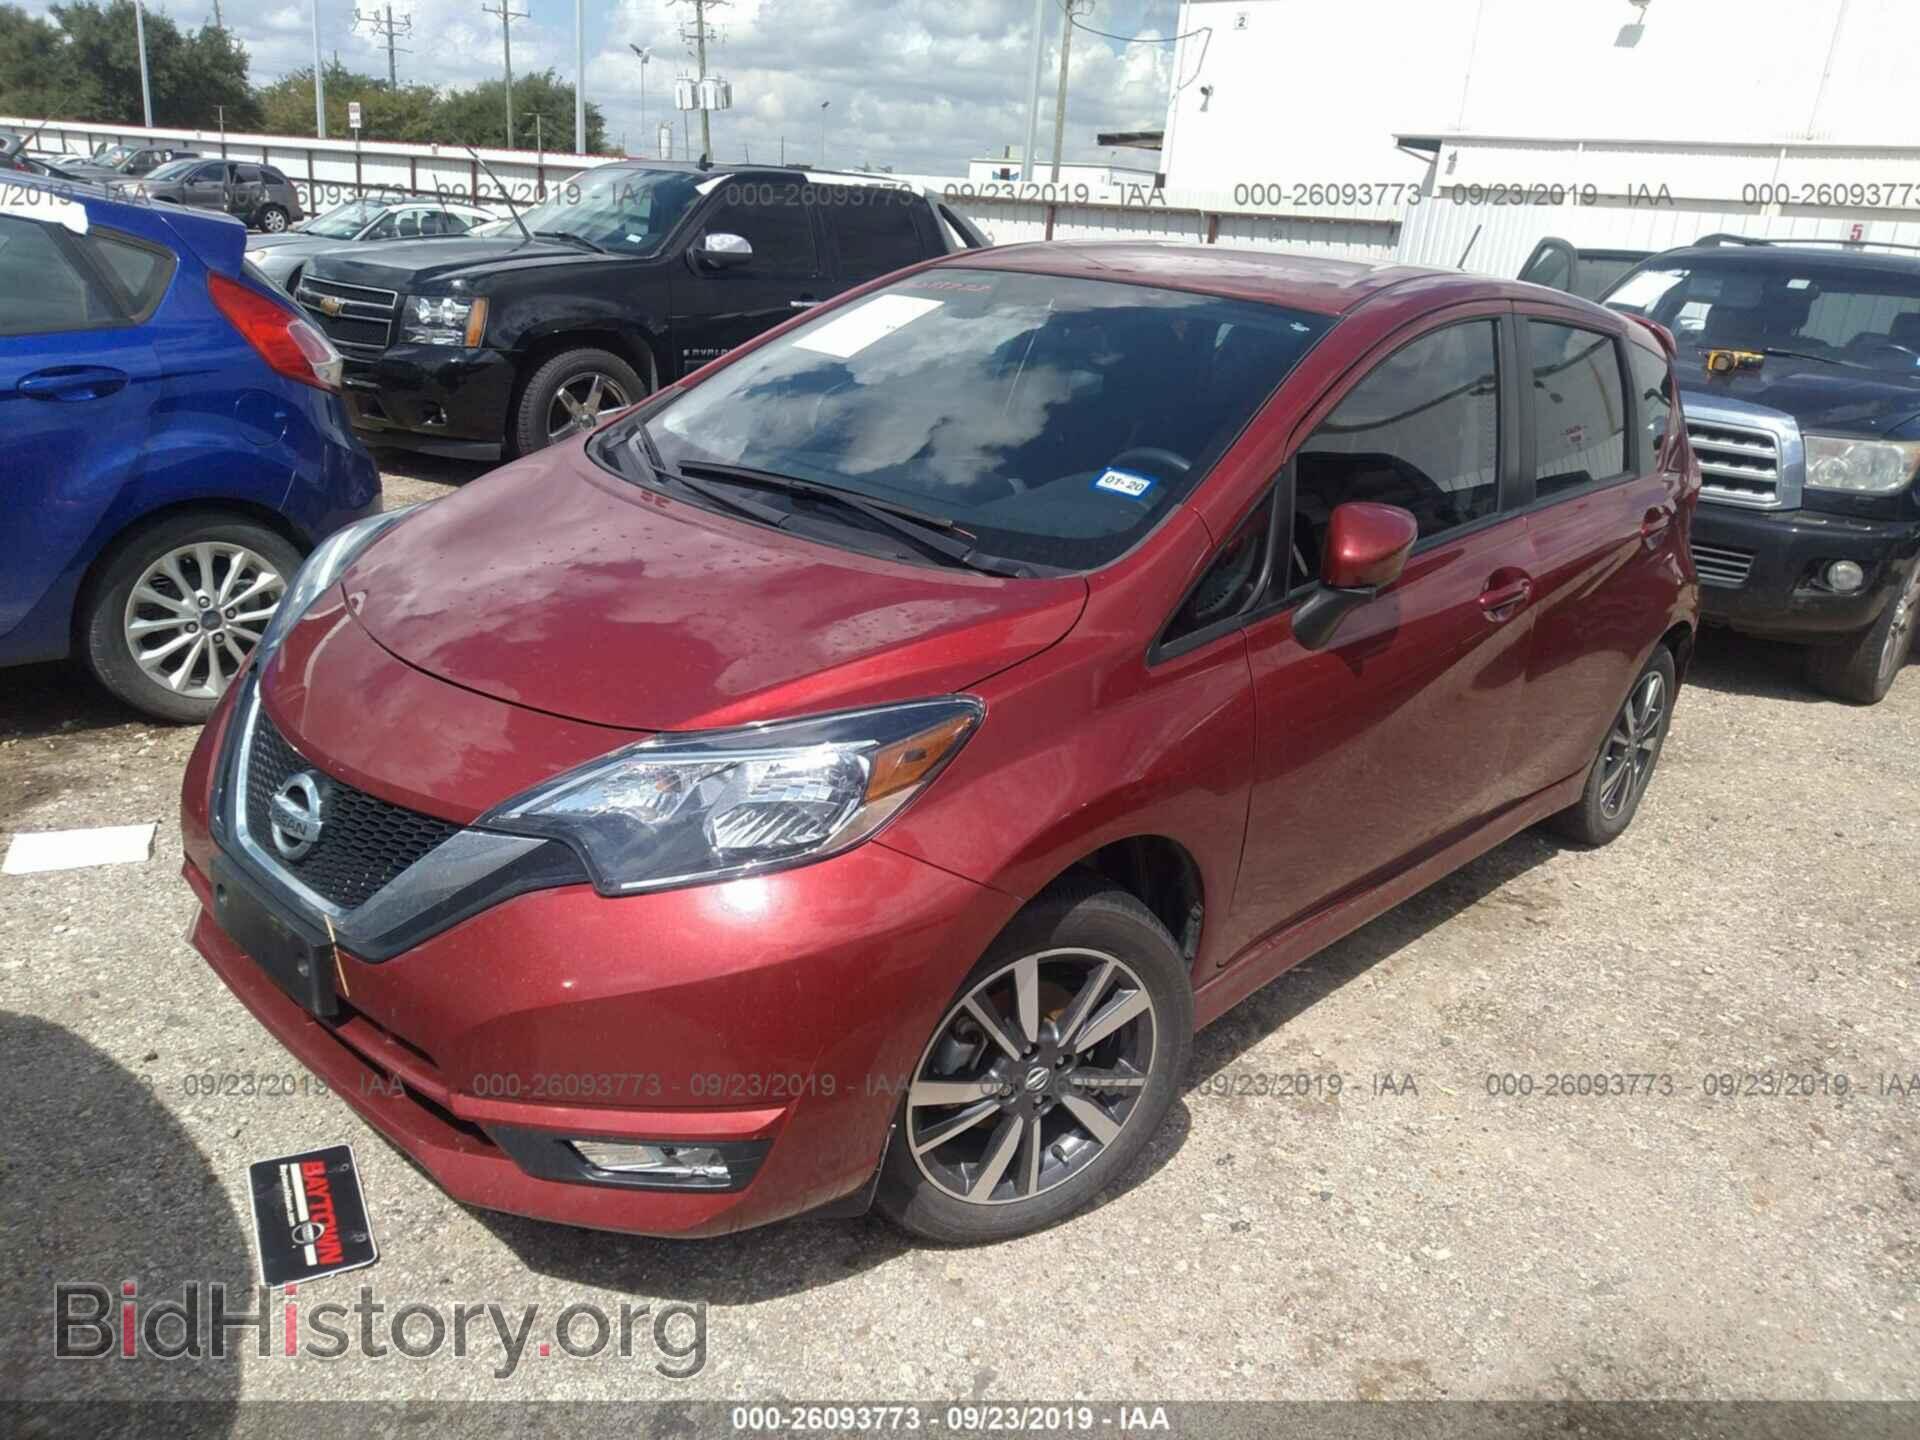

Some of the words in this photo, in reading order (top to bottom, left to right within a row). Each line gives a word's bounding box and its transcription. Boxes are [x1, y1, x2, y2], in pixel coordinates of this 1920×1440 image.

[1238, 16, 1246, 28] 2
[1850, 223, 1864, 241] 5
[1104, 475, 1145, 491] 01-20
[300, 1160, 344, 1265] BAYTOWN
